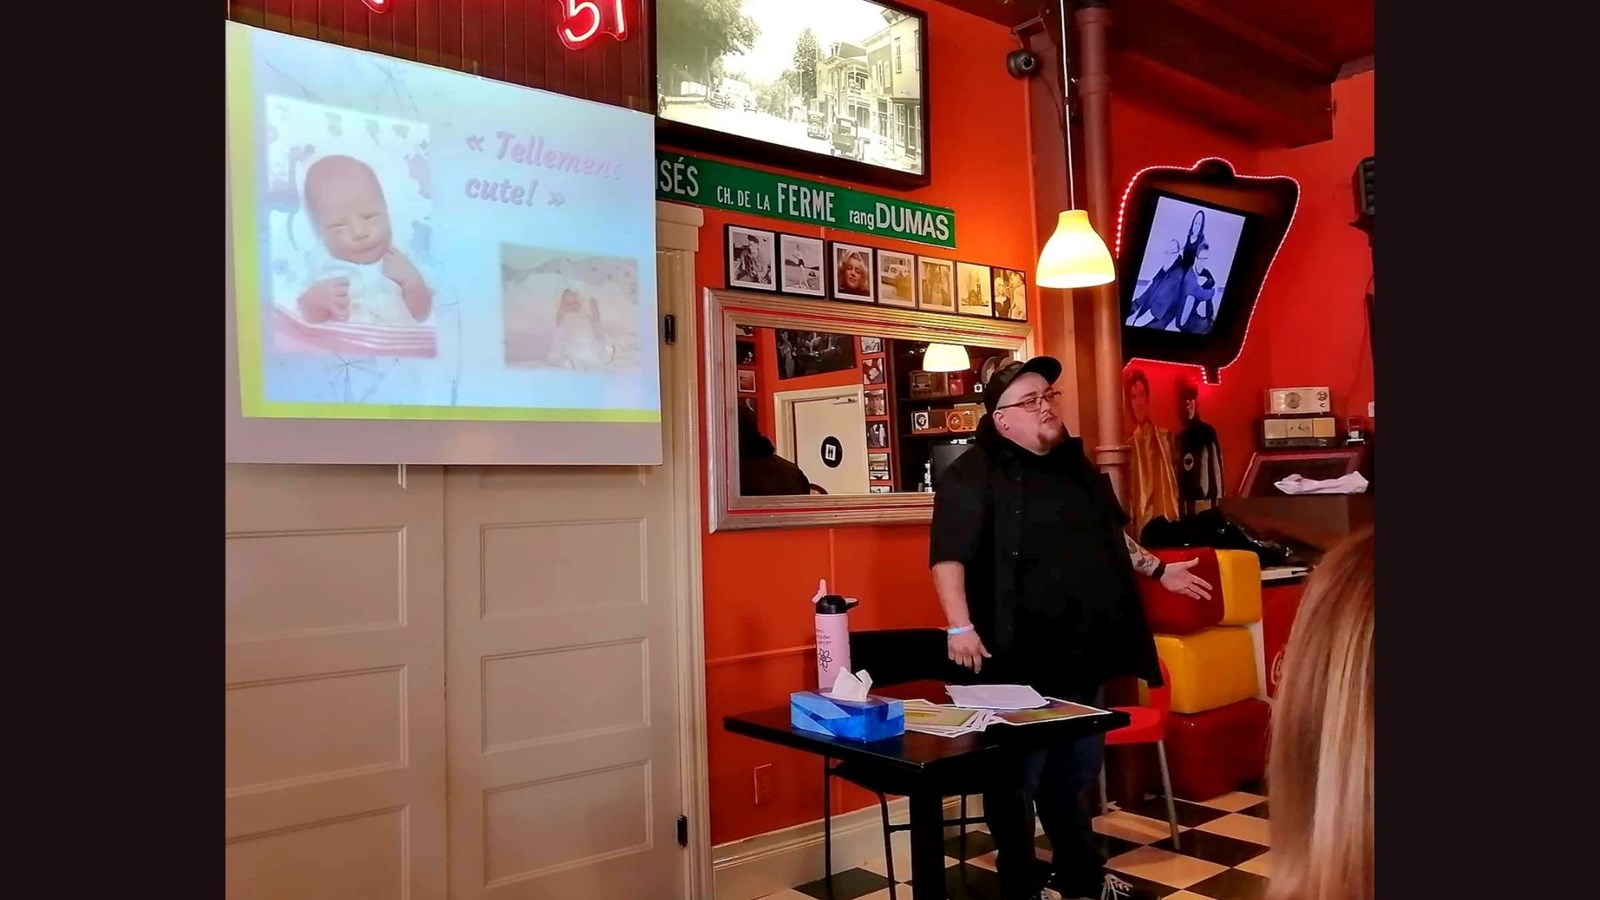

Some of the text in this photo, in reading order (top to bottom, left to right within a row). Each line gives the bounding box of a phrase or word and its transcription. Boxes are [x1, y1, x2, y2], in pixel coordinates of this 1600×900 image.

[496, 130, 622, 180] Tellement
[465, 178, 539, 207] cute!
[717, 182, 836, 223] CH. DE LA FERME
[849, 202, 949, 241] rang DUMAS
